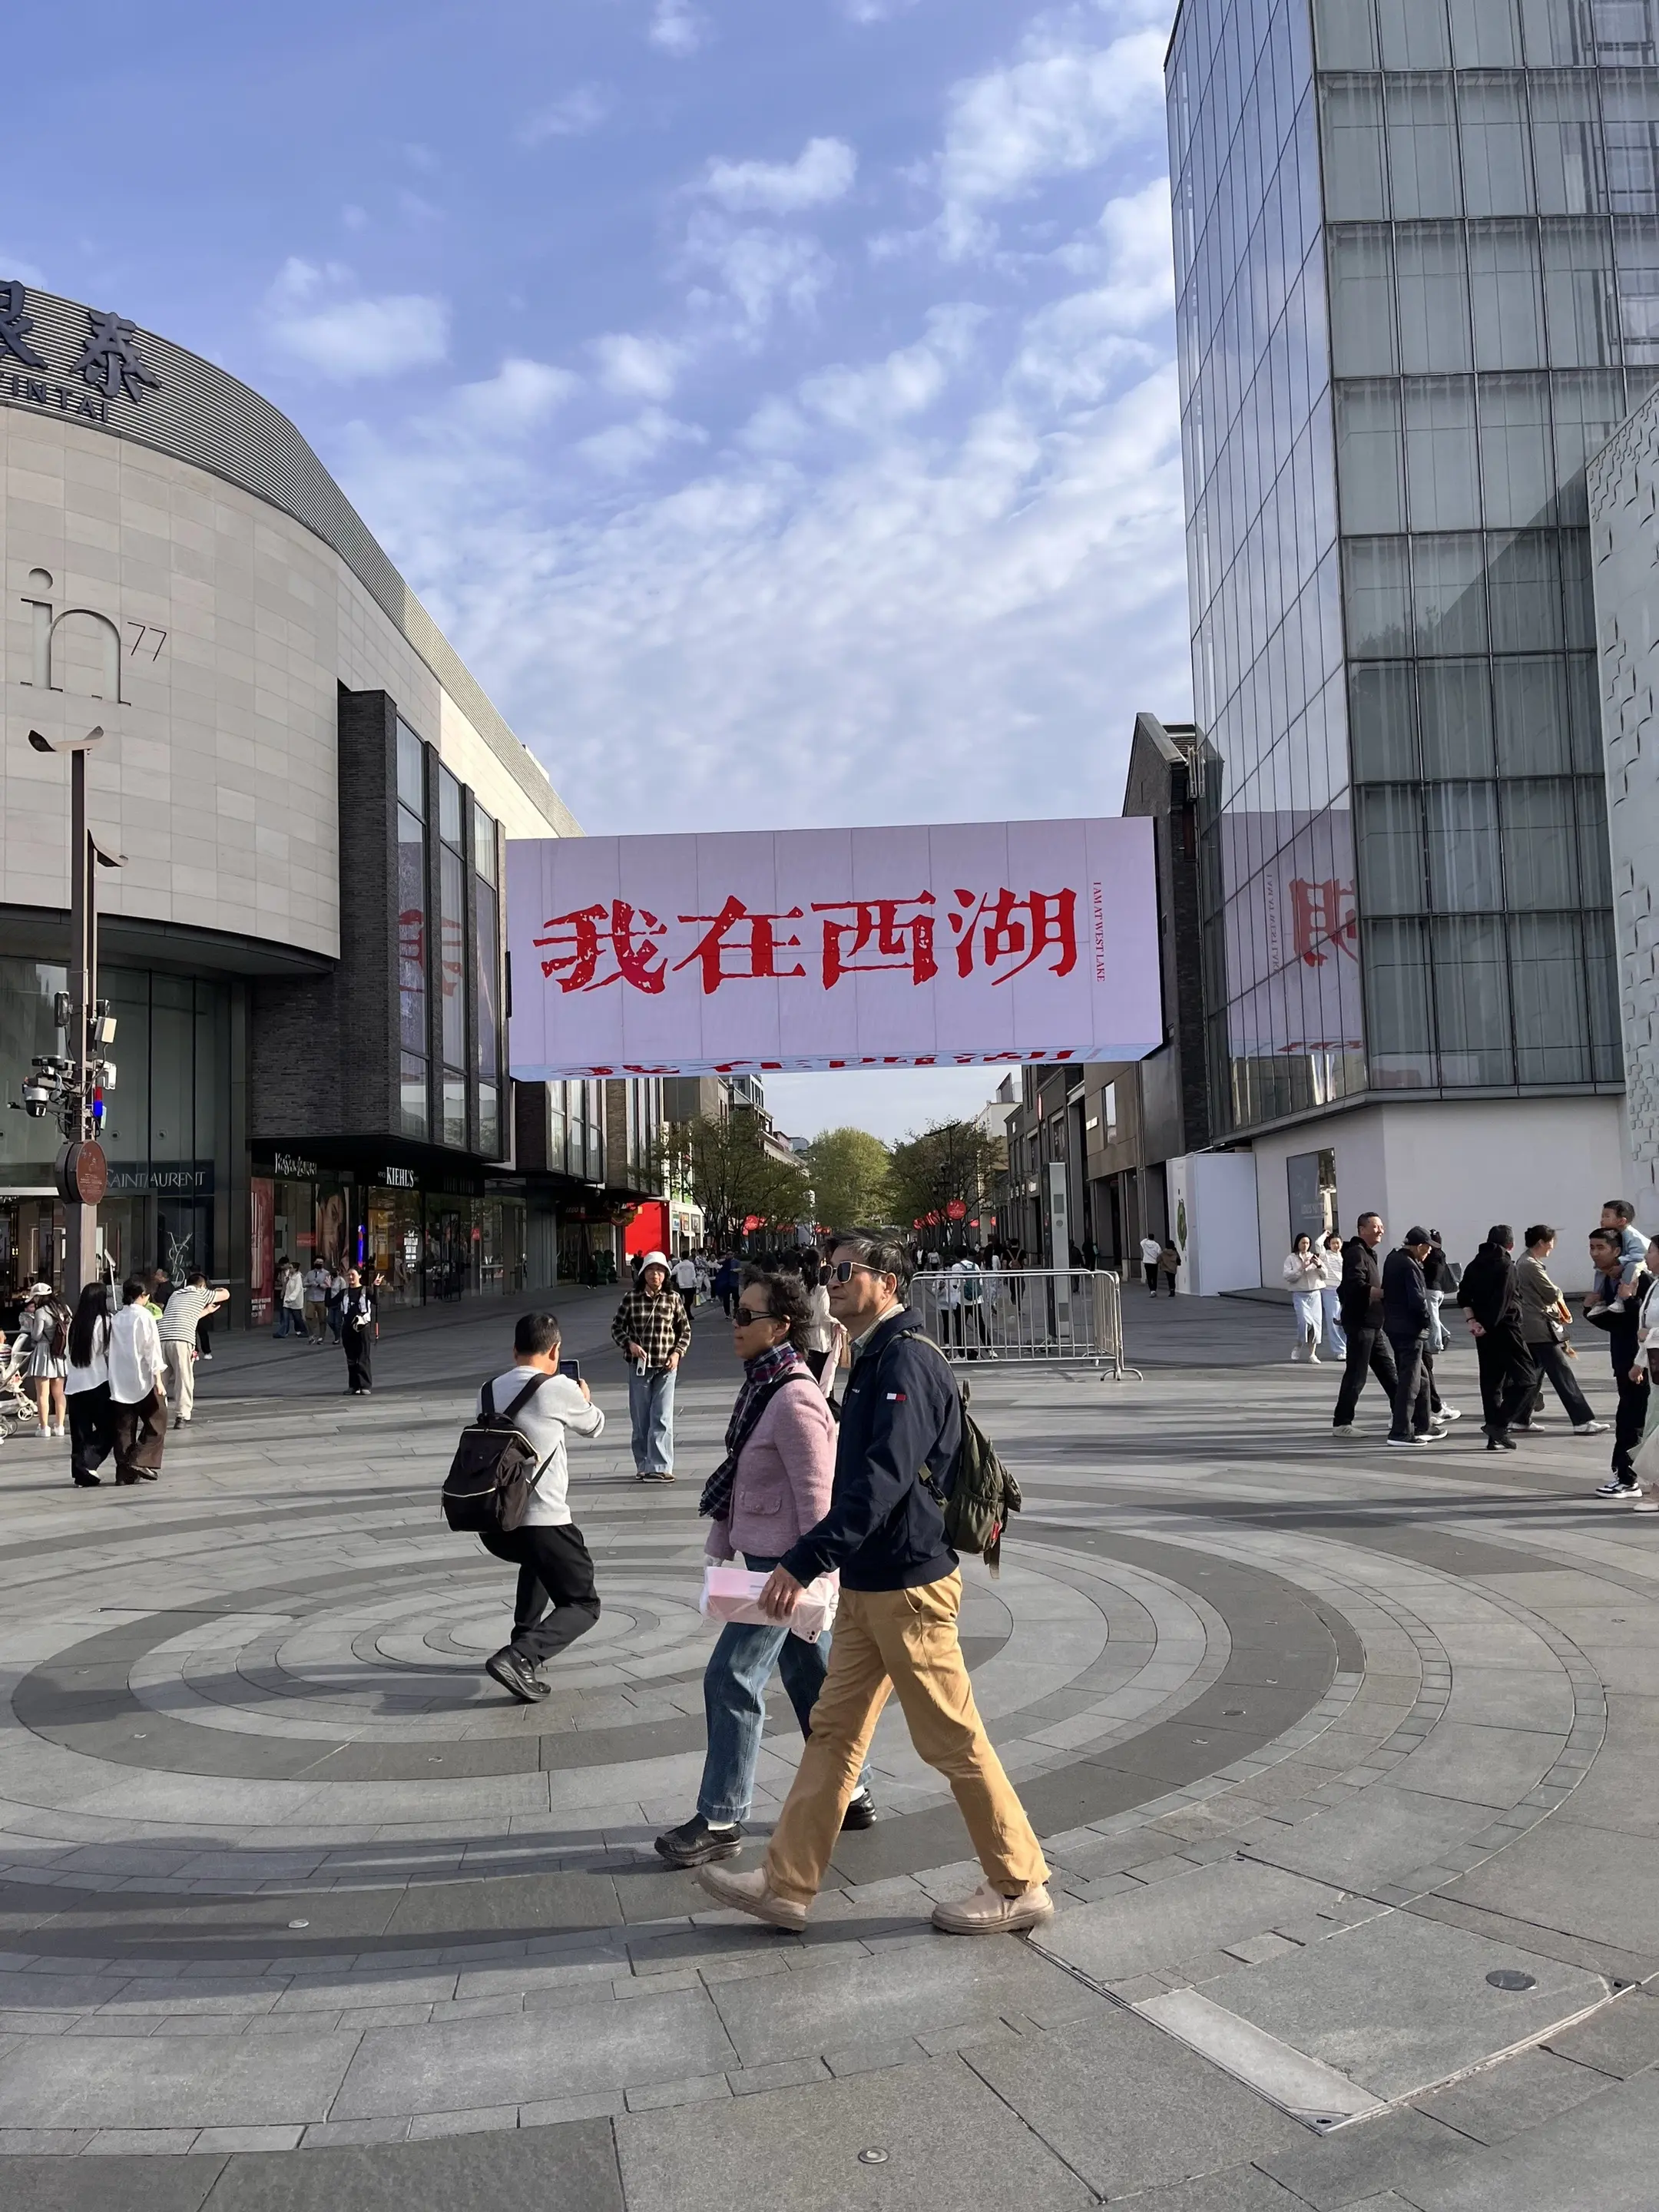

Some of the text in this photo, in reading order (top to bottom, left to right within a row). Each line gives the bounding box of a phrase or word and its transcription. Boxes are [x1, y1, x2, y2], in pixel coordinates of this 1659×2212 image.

[0, 373, 109, 422] INTAI
[1093, 887, 1102, 904] AM
[1094, 906, 1103, 921] AT
[533, 887, 1078, 995] 我在西湖
[1094, 922, 1104, 952] WEST
[1096, 954, 1105, 982] LAKE
[386, 1166, 415, 1188] KIEHL'S
